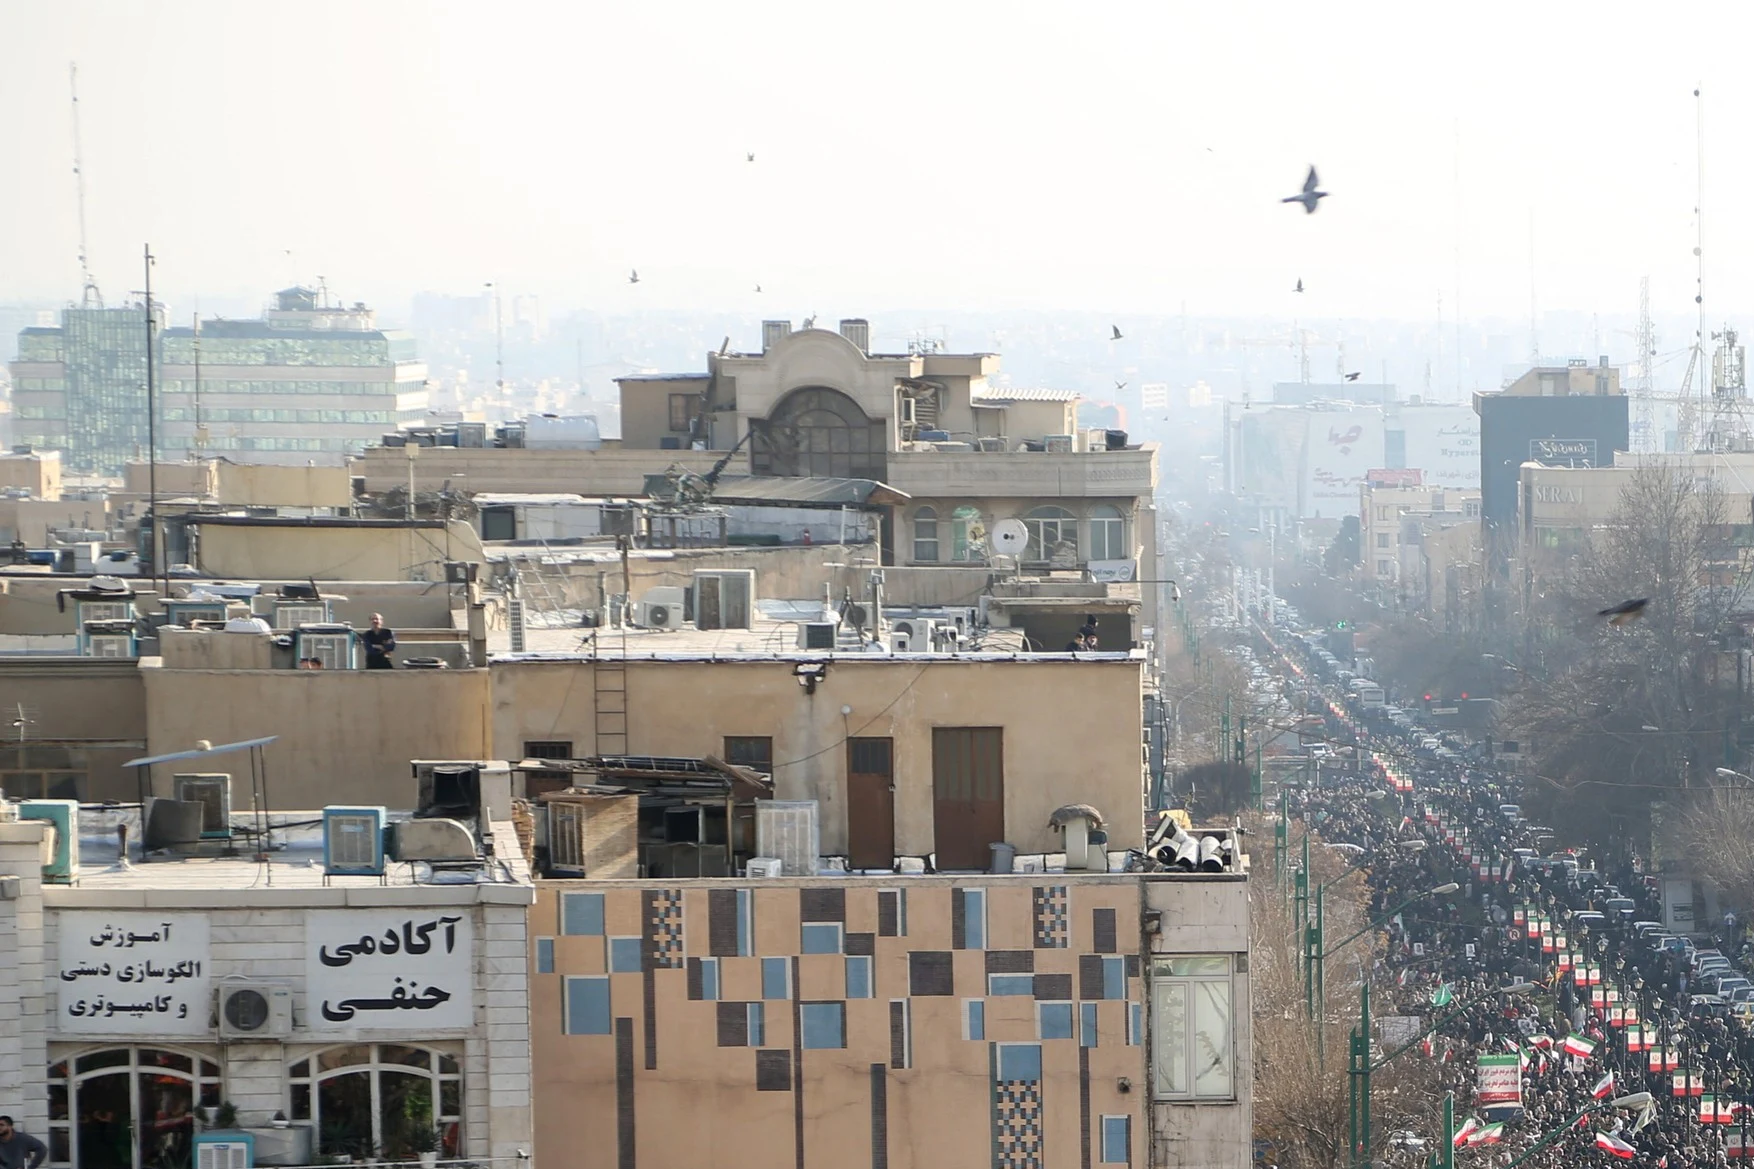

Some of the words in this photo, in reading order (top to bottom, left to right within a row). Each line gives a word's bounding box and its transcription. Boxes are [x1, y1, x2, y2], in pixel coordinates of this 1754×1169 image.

[89, 923, 172, 948] آموزش
[319, 916, 462, 967] آکادمی
[60, 961, 110, 982] دستی
[116, 960, 201, 983] الگوسازی
[68, 995, 172, 1019] کامپیوتری
[177, 1004, 187, 1018] و
[321, 977, 451, 1022] حنفی
